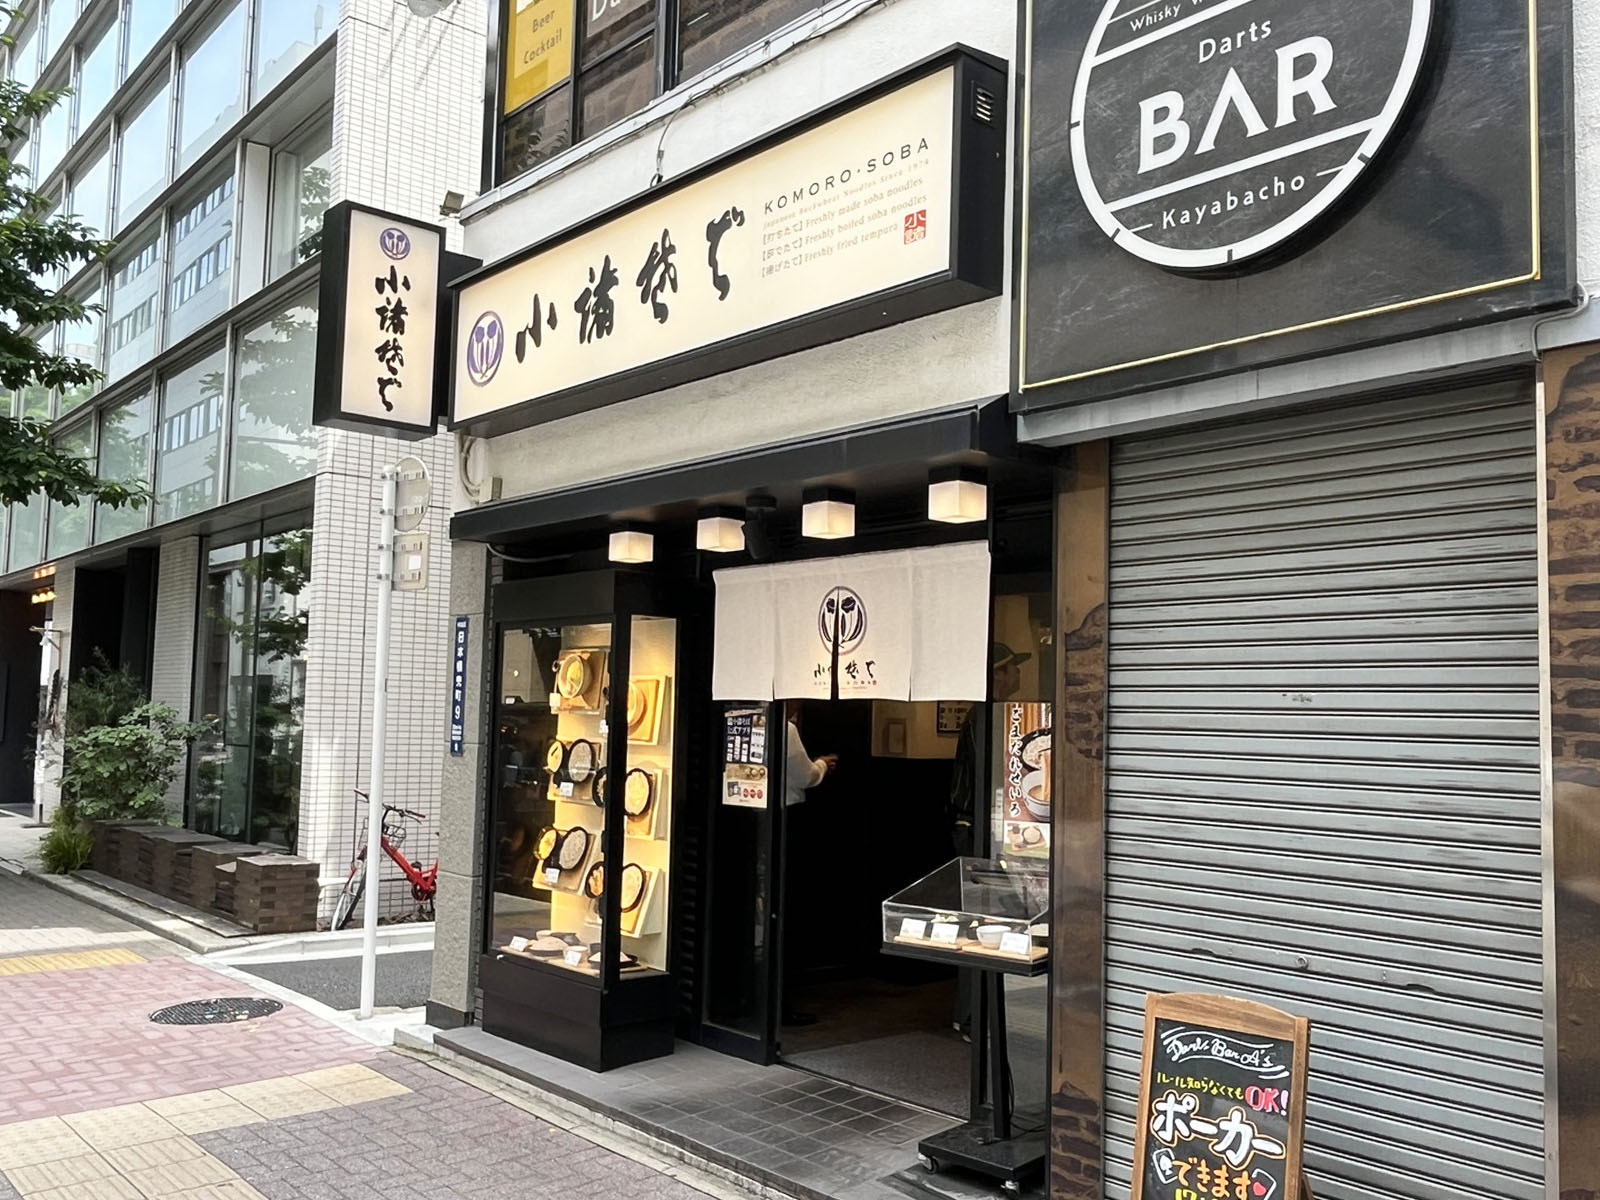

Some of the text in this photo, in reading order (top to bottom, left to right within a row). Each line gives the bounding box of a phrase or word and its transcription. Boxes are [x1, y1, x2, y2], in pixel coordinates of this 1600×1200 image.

[532, 10, 555, 33] Beer
[1130, 4, 1180, 31] Whisky
[524, 28, 562, 64] Cocktail
[1199, 20, 1271, 64] Darts
[1137, 36, 1337, 175] BAR
[805, 211, 835, 227] Freshly
[838, 200, 861, 216] made
[864, 191, 884, 206] soba
[887, 177, 923, 197] noodles
[805, 227, 835, 244] Freshly
[837, 215, 865, 233] boiled
[867, 207, 888, 222] soba
[891, 195, 927, 213] noodles
[1163, 175, 1305, 230] Kayabacho
[804, 244, 834, 262] Freshly
[837, 234, 859, 251] fried
[861, 223, 898, 243] tempura
[1245, 1086, 1289, 1116] OK!
[1152, 1092, 1284, 1167] ポーカー
[1172, 1157, 1251, 1200] できます
